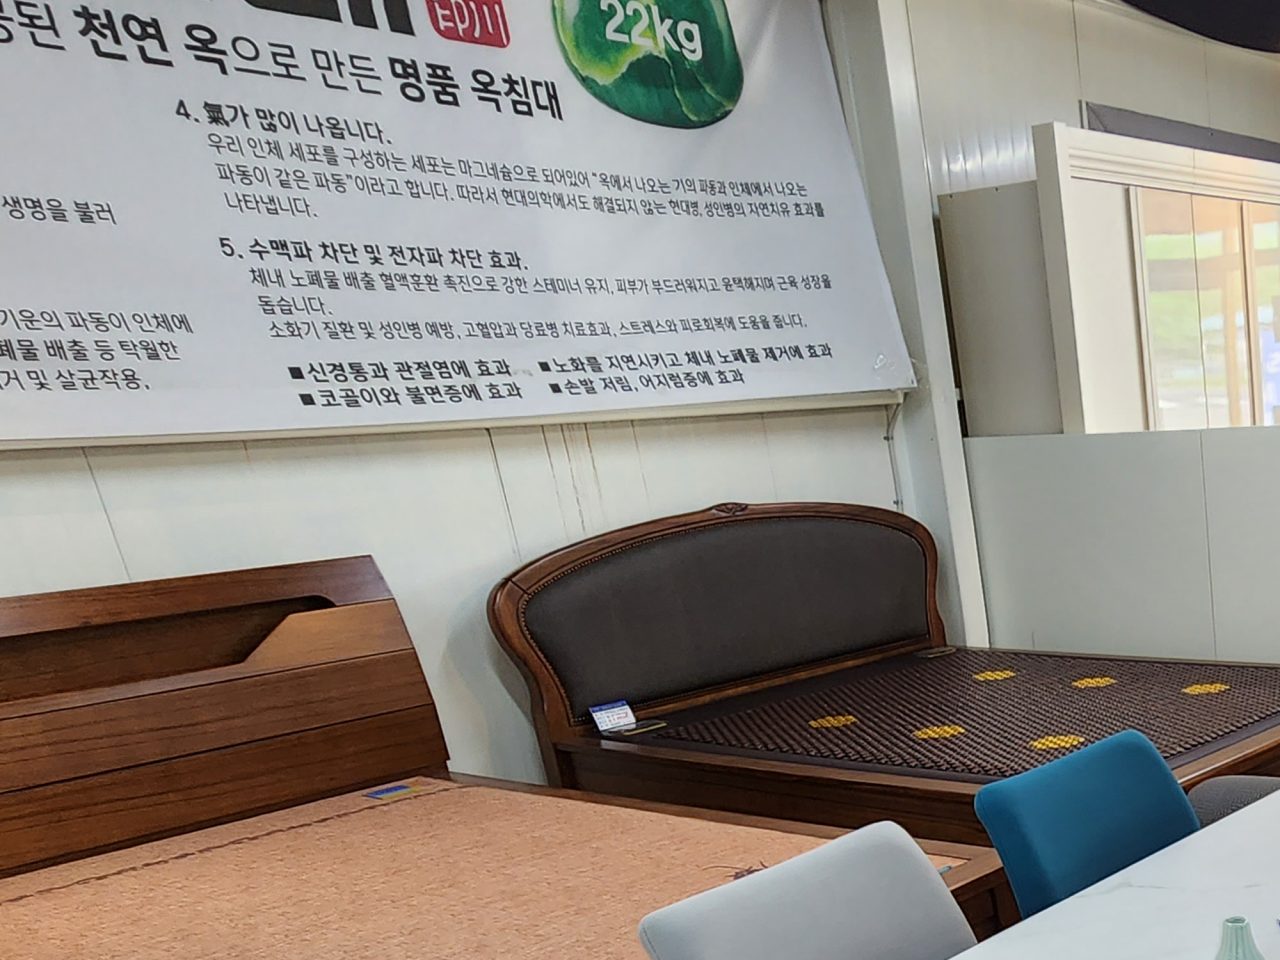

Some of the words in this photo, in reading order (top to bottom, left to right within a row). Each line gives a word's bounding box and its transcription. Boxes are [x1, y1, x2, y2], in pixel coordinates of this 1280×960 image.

[600, 0, 702, 61] 22kg
[73, 4, 174, 67] 천연
[184, 24, 306, 81] 옥으로
[310, 48, 382, 95] 만든
[388, 56, 461, 107] 명품
[470, 68, 564, 120] 옥침대
[175, 99, 200, 123] 4.
[254, 107, 300, 135] 많이
[302, 113, 392, 145] 나옵니다.
[207, 132, 245, 156] 우리
[246, 137, 284, 161] 인체
[288, 141, 340, 167] 세포를
[343, 147, 407, 173] 구성하는
[411, 154, 456, 177] 세포는
[458, 158, 540, 183] 마그네슘으로
[542, 168, 591, 188] 되어있어
[634, 177, 671, 194] 나오는
[671, 178, 697, 195] 기의
[698, 179, 727, 196] 파동과
[728, 180, 774, 197] 인체에서
[775, 181, 808, 197] 나오는
[214, 162, 272, 187] 파동이
[274, 167, 311, 191] 같은
[404, 179, 455, 201] 합니다.
[456, 184, 499, 205] 따라서
[500, 187, 591, 211] 현대의학에서도
[593, 196, 639, 215] 해결되지
[640, 199, 667, 216] 않는
[703, 202, 746, 218] 성인병의
[748, 202, 791, 218] 자연치유
[792, 202, 825, 218] 효과를
[1, 195, 69, 223] 생명을
[73, 200, 118, 225] 불러
[223, 192, 318, 218] 나타냅니다.
[218, 237, 244, 259] 5.
[248, 238, 313, 262] 수맥파
[318, 241, 360, 265] 차단
[363, 244, 385, 266] 및
[388, 245, 444, 267] 전자파
[449, 248, 484, 269] 차단
[488, 250, 529, 270] 효과.
[249, 267, 287, 288] 체내
[290, 269, 341, 290] 노폐물
[342, 270, 377, 291] 배출
[443, 273, 500, 294] 촉진으로
[501, 276, 529, 294] 강한
[532, 277, 583, 295] 스테미너
[616, 277, 649, 295] 피부가
[651, 277, 720, 295] 부드러워지고
[722, 276, 775, 292] 윤택해지며
[776, 275, 799, 291] 근육
[800, 274, 832, 290] 성장을
[257, 295, 333, 316] 돕습니다.
[0, 308, 66, 332] 기운의
[64, 310, 132, 333] 파동이
[131, 312, 194, 334] 인체에
[269, 320, 321, 341] 소화기
[322, 320, 357, 340] 질환
[358, 320, 377, 341] 및
[378, 321, 424, 341] 성인병
[462, 321, 519, 340] 고혈압과
[619, 319, 679, 336] 스트레스와
[679, 316, 737, 333] 피로회복에
[737, 314, 771, 331] 도움을
[772, 313, 808, 329] 줍니다.
[43, 338, 91, 361] 배출
[93, 339, 115, 361] 등
[117, 339, 181, 361] 탁월한
[552, 356, 604, 373] 노화를
[605, 352, 684, 373] 지연시키고
[685, 350, 717, 368] 체내
[719, 348, 760, 365] 노폐물
[762, 344, 805, 362] 제거에
[806, 342, 833, 360] 효과
[0, 369, 26, 391] 거
[26, 369, 53, 391] 및
[307, 361, 390, 384] 신경통과
[393, 360, 472, 381] 관절염에
[474, 358, 514, 377] 효과
[564, 377, 596, 396] 손발
[599, 374, 639, 394] 저림,
[639, 370, 714, 391] 어지럼증에
[716, 368, 746, 385] 효과
[317, 386, 402, 408] 코골이와
[405, 383, 484, 405] 불면증에
[485, 381, 524, 400] 효과
